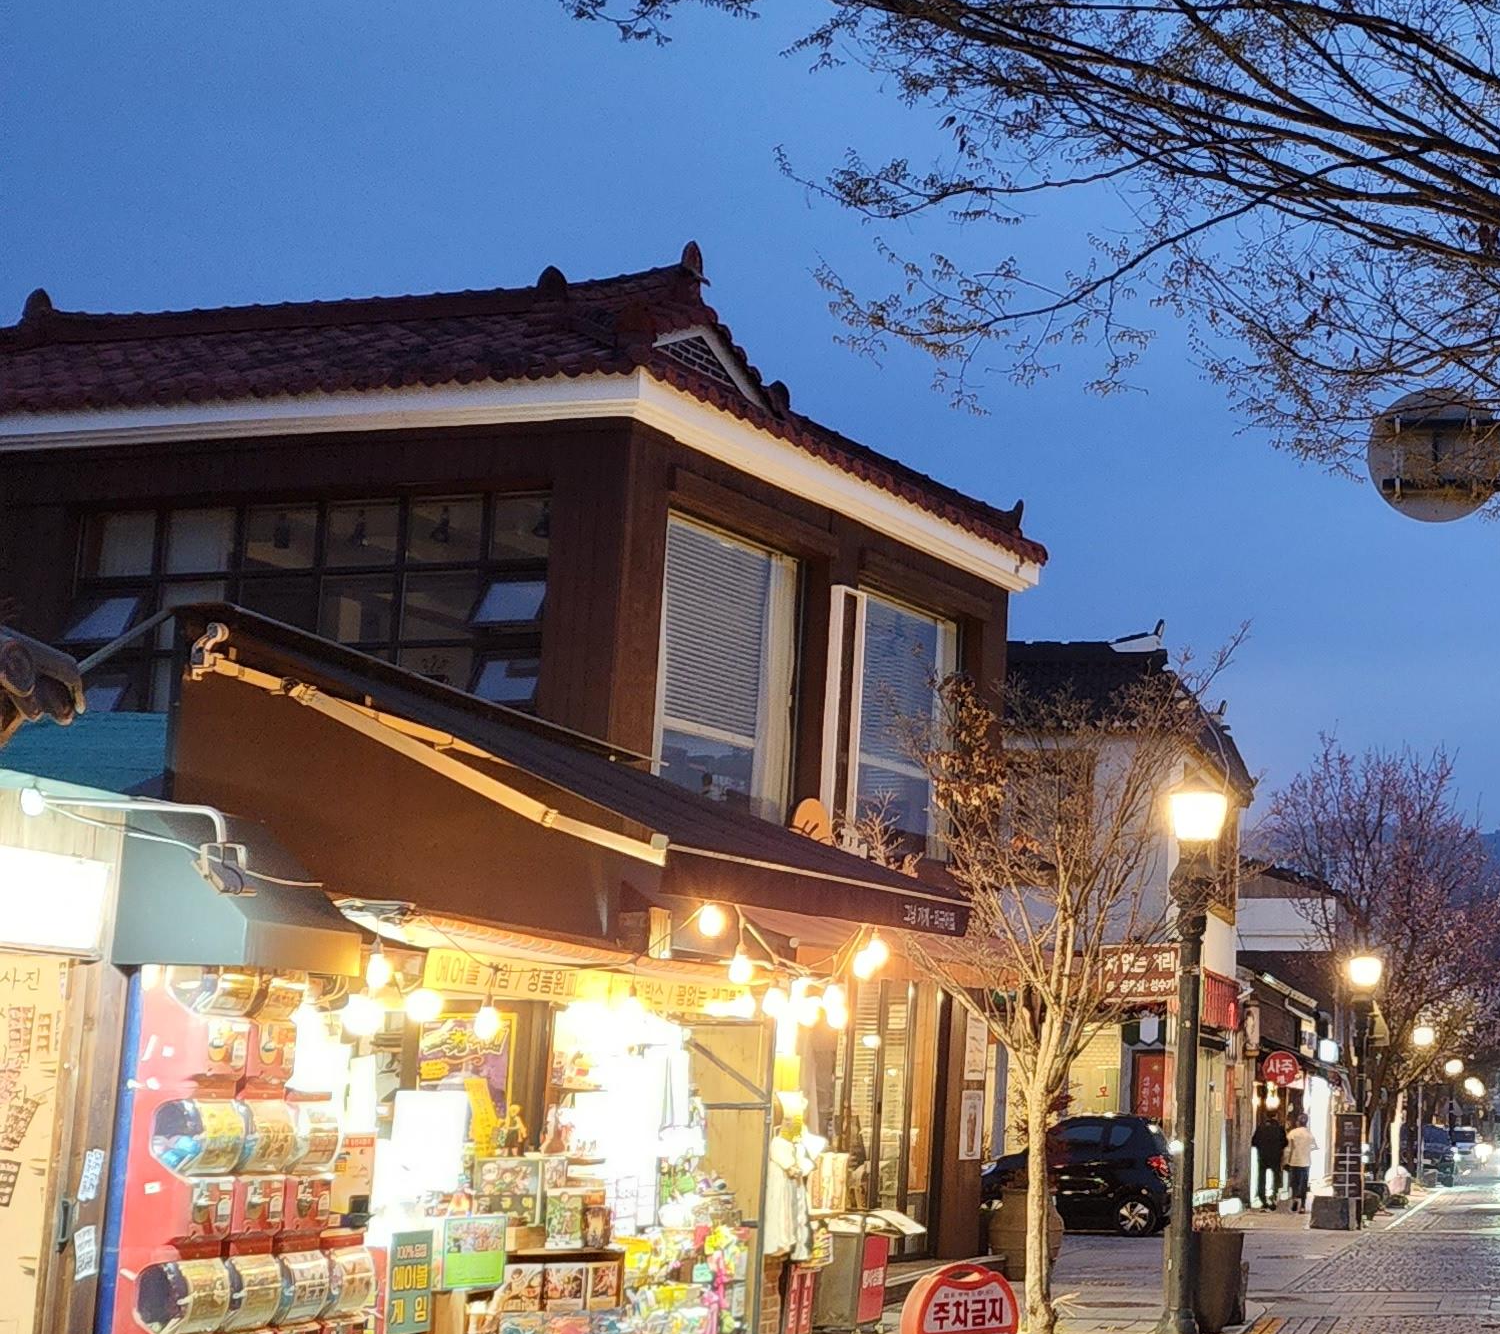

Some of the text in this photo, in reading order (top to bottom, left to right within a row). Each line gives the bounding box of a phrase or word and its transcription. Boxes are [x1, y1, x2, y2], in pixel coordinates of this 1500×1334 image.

[1266, 1058, 1295, 1074] 사주
[391, 1263, 429, 1292] 에어볼
[932, 1296, 1004, 1331] 주차금지
